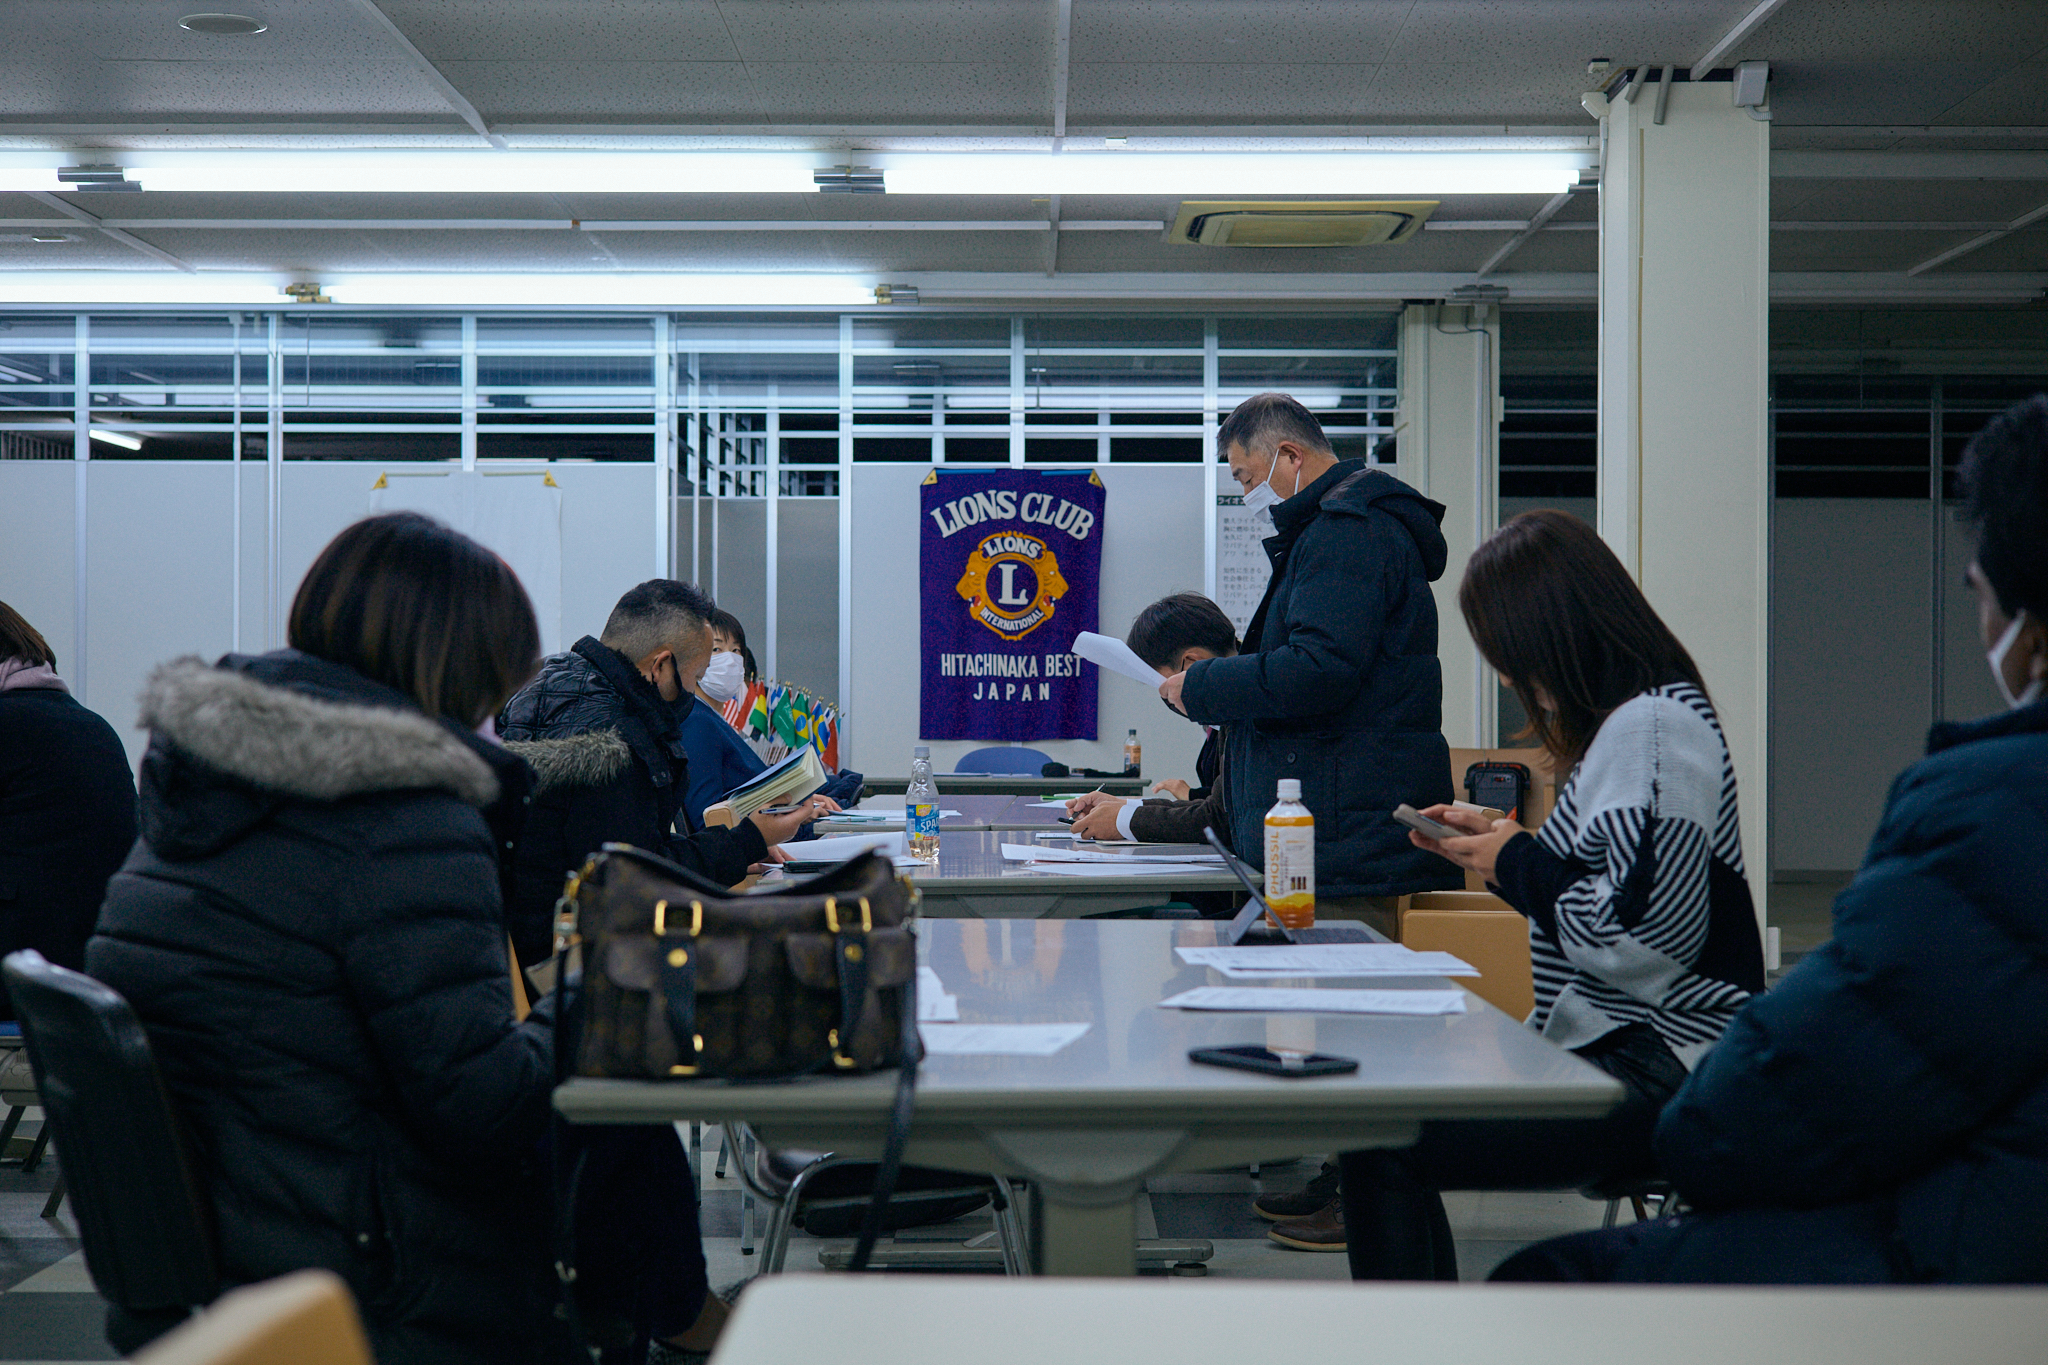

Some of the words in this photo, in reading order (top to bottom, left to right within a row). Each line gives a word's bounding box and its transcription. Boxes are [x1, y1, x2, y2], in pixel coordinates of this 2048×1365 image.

[930, 489, 1017, 538] LIONS
[1020, 492, 1094, 540] CLUB
[983, 536, 1042, 559] LIONS
[998, 563, 1029, 605] L
[980, 606, 1045, 631] INTERNATIONAL
[941, 653, 1039, 678] HITACHINAKA
[1045, 653, 1084, 677] BEST
[973, 682, 1050, 701] JAPAN
[1270, 831, 1279, 895] PHOSSIL
